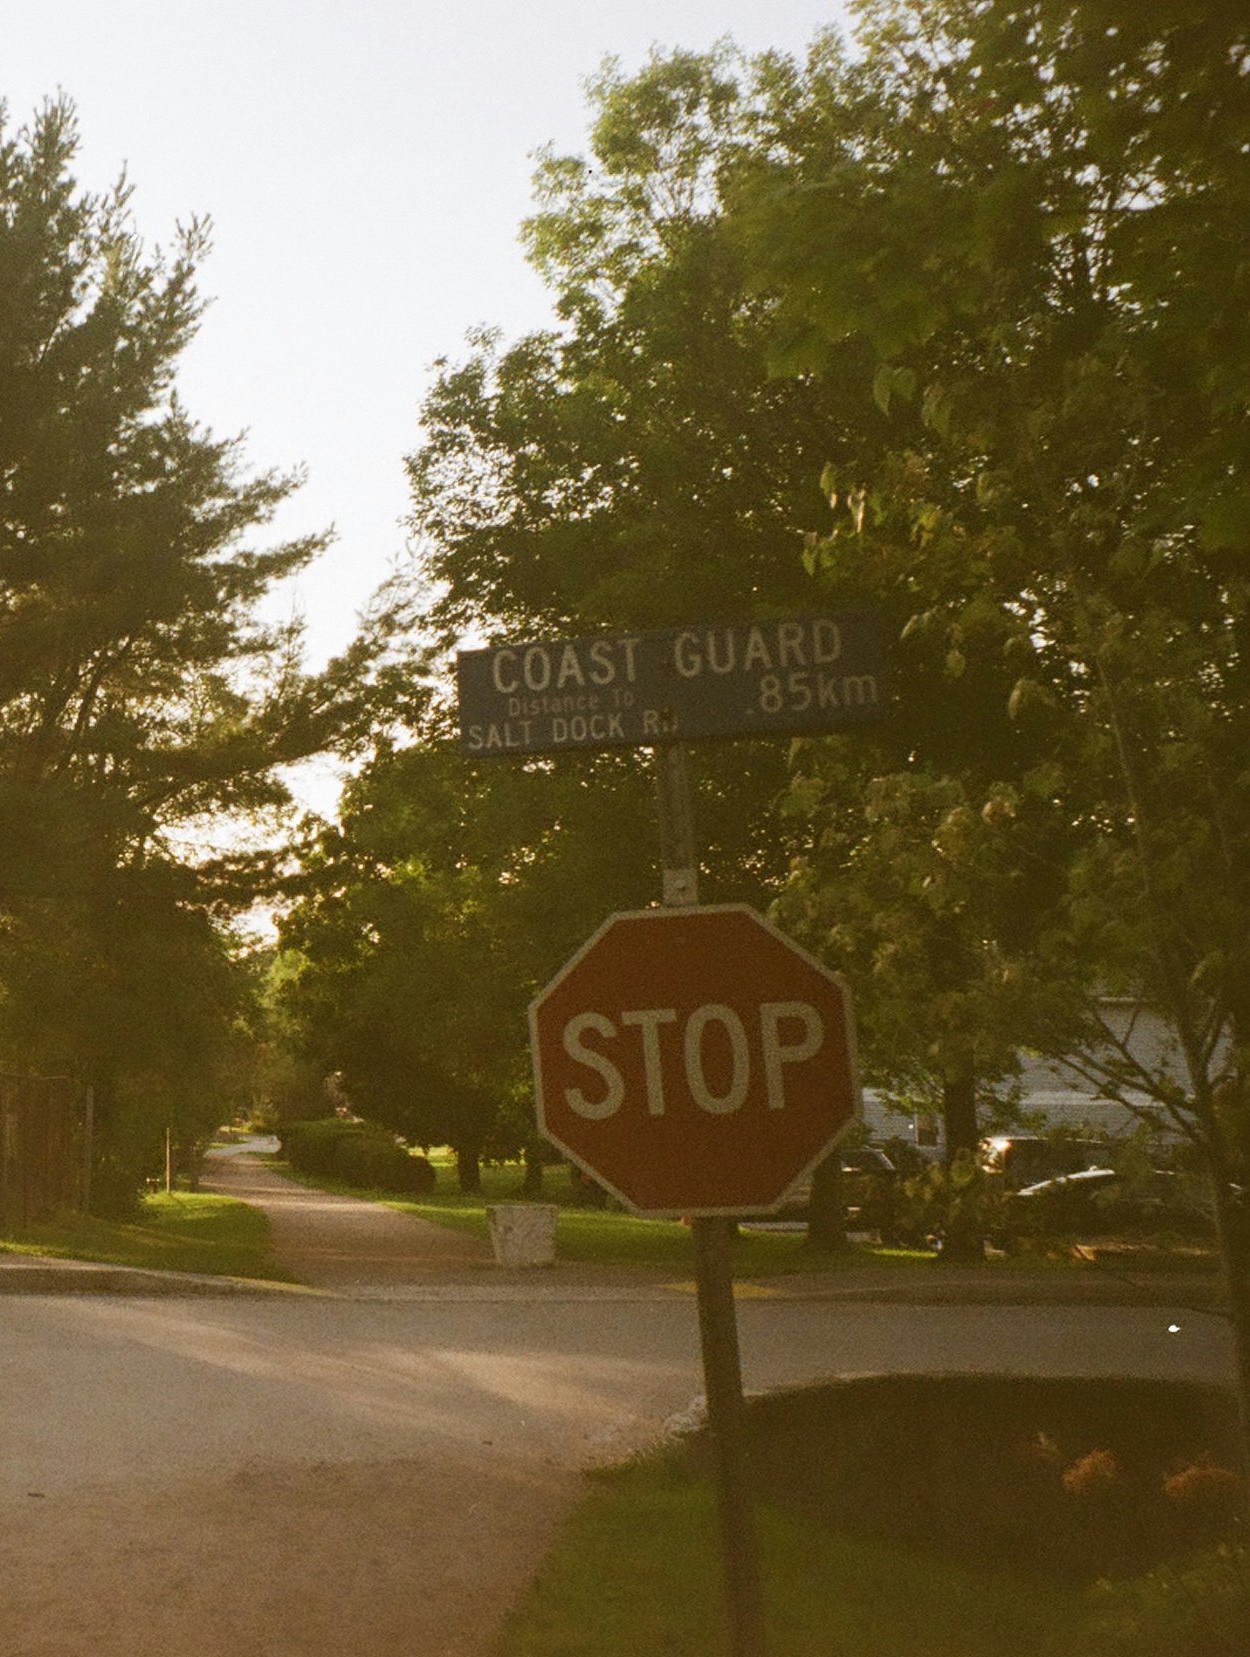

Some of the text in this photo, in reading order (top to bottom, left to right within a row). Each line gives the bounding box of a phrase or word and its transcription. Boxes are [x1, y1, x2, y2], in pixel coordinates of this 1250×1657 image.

[492, 618, 843, 694] COAST GUARD
[508, 689, 635, 718] Distance To
[468, 719, 535, 750] SALT
[553, 714, 625, 743] DOCK
[562, 1001, 824, 1120] STOP
